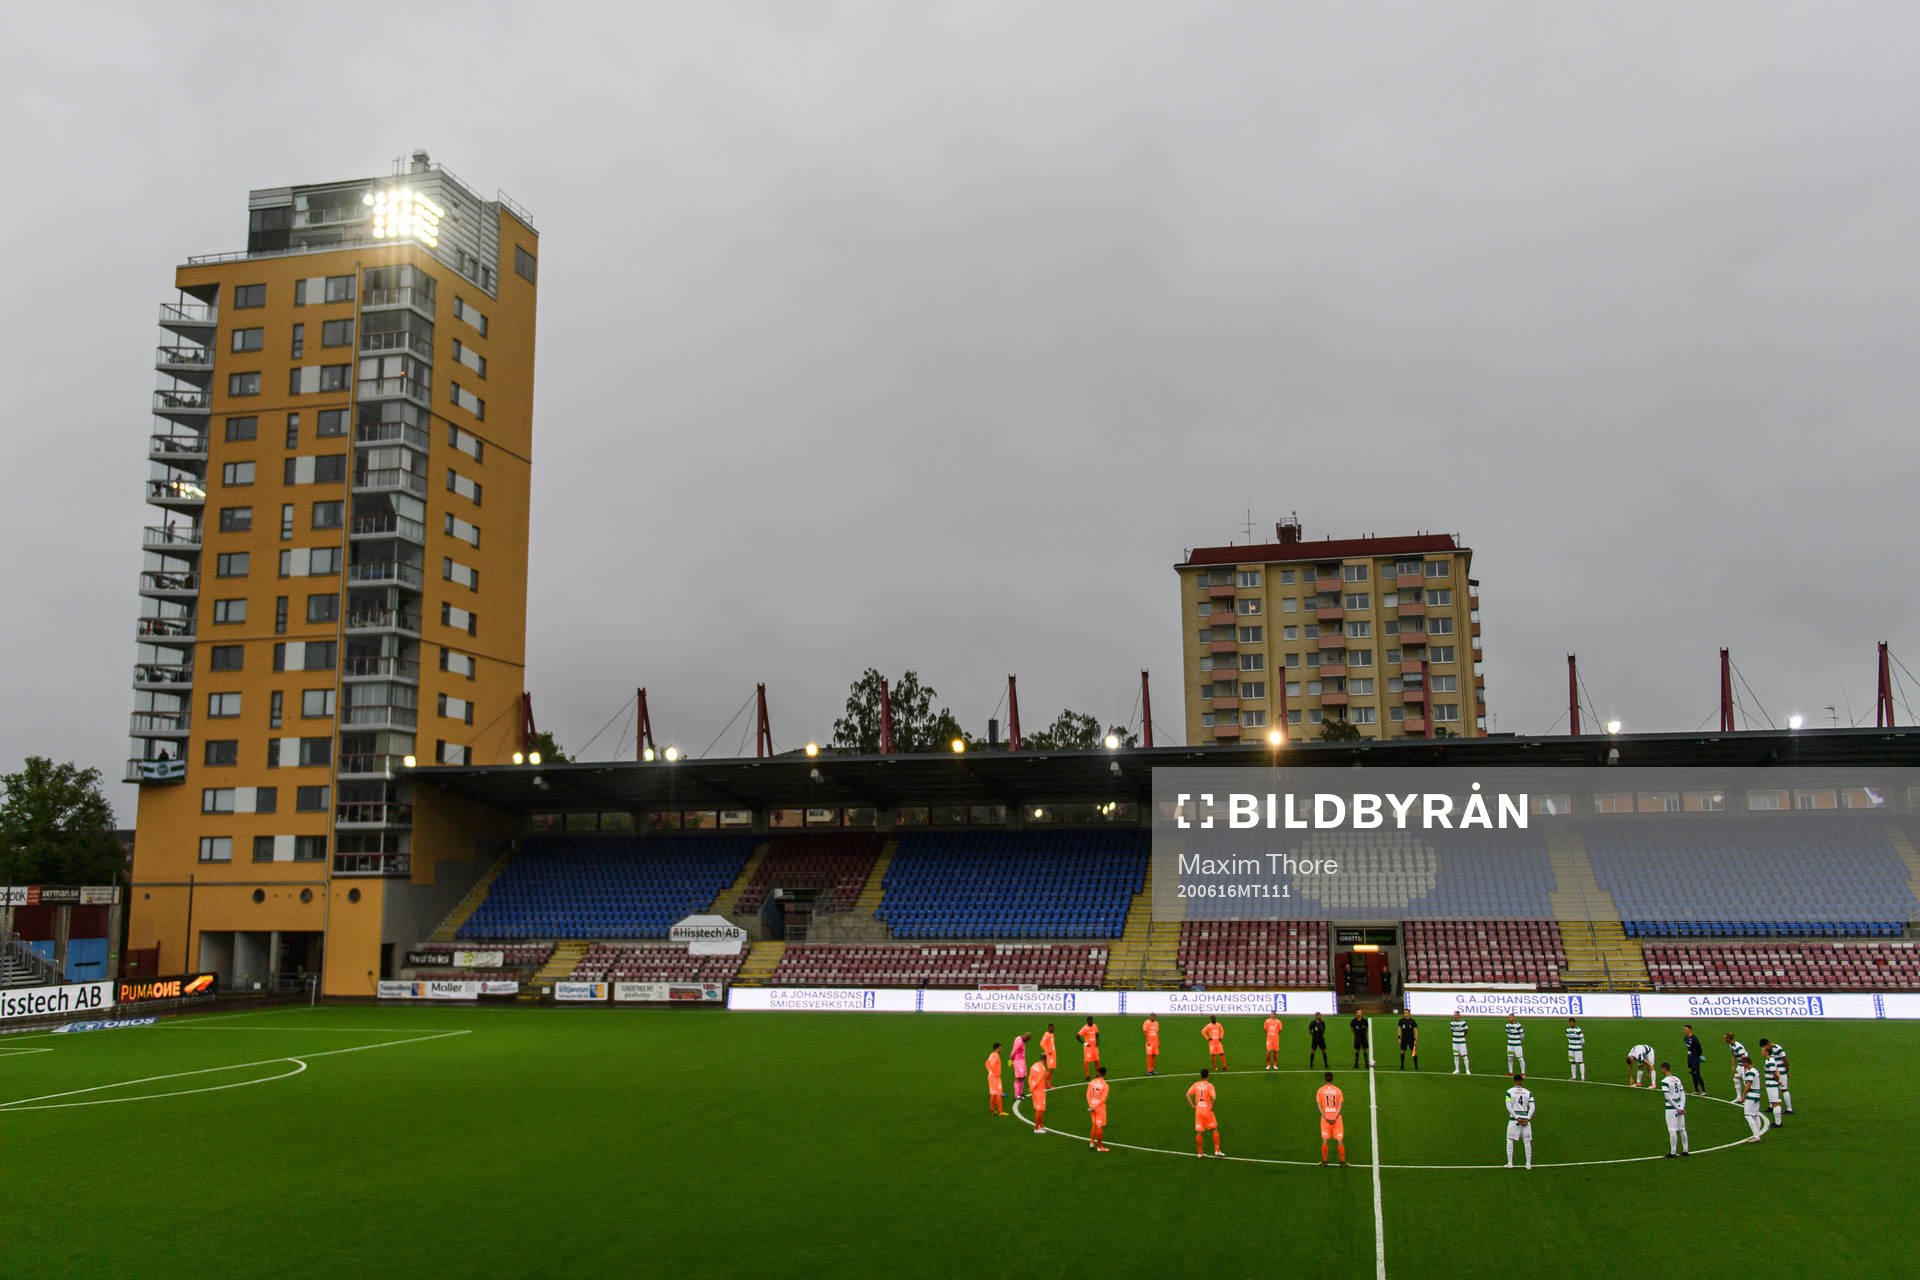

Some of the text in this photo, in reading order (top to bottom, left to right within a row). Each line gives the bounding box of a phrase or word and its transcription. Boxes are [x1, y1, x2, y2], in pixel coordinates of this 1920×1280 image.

[680, 927, 740, 938] Hisstech AB
[75, 985, 101, 1009] AB
[769, 1000, 863, 1009] SMIDESVERKSTAD
[964, 1002, 1062, 1011] SMIDESVERKSTAD
[1169, 1003, 1273, 1012] SMIDESVERKSTAD
[1457, 1005, 1568, 1015] SMIDESVERKSTAD
[1690, 1007, 1808, 1016] SMIDESVERKSTAD
[1325, 1094, 1336, 1107] 13
[1517, 1095, 1524, 1106] 4
